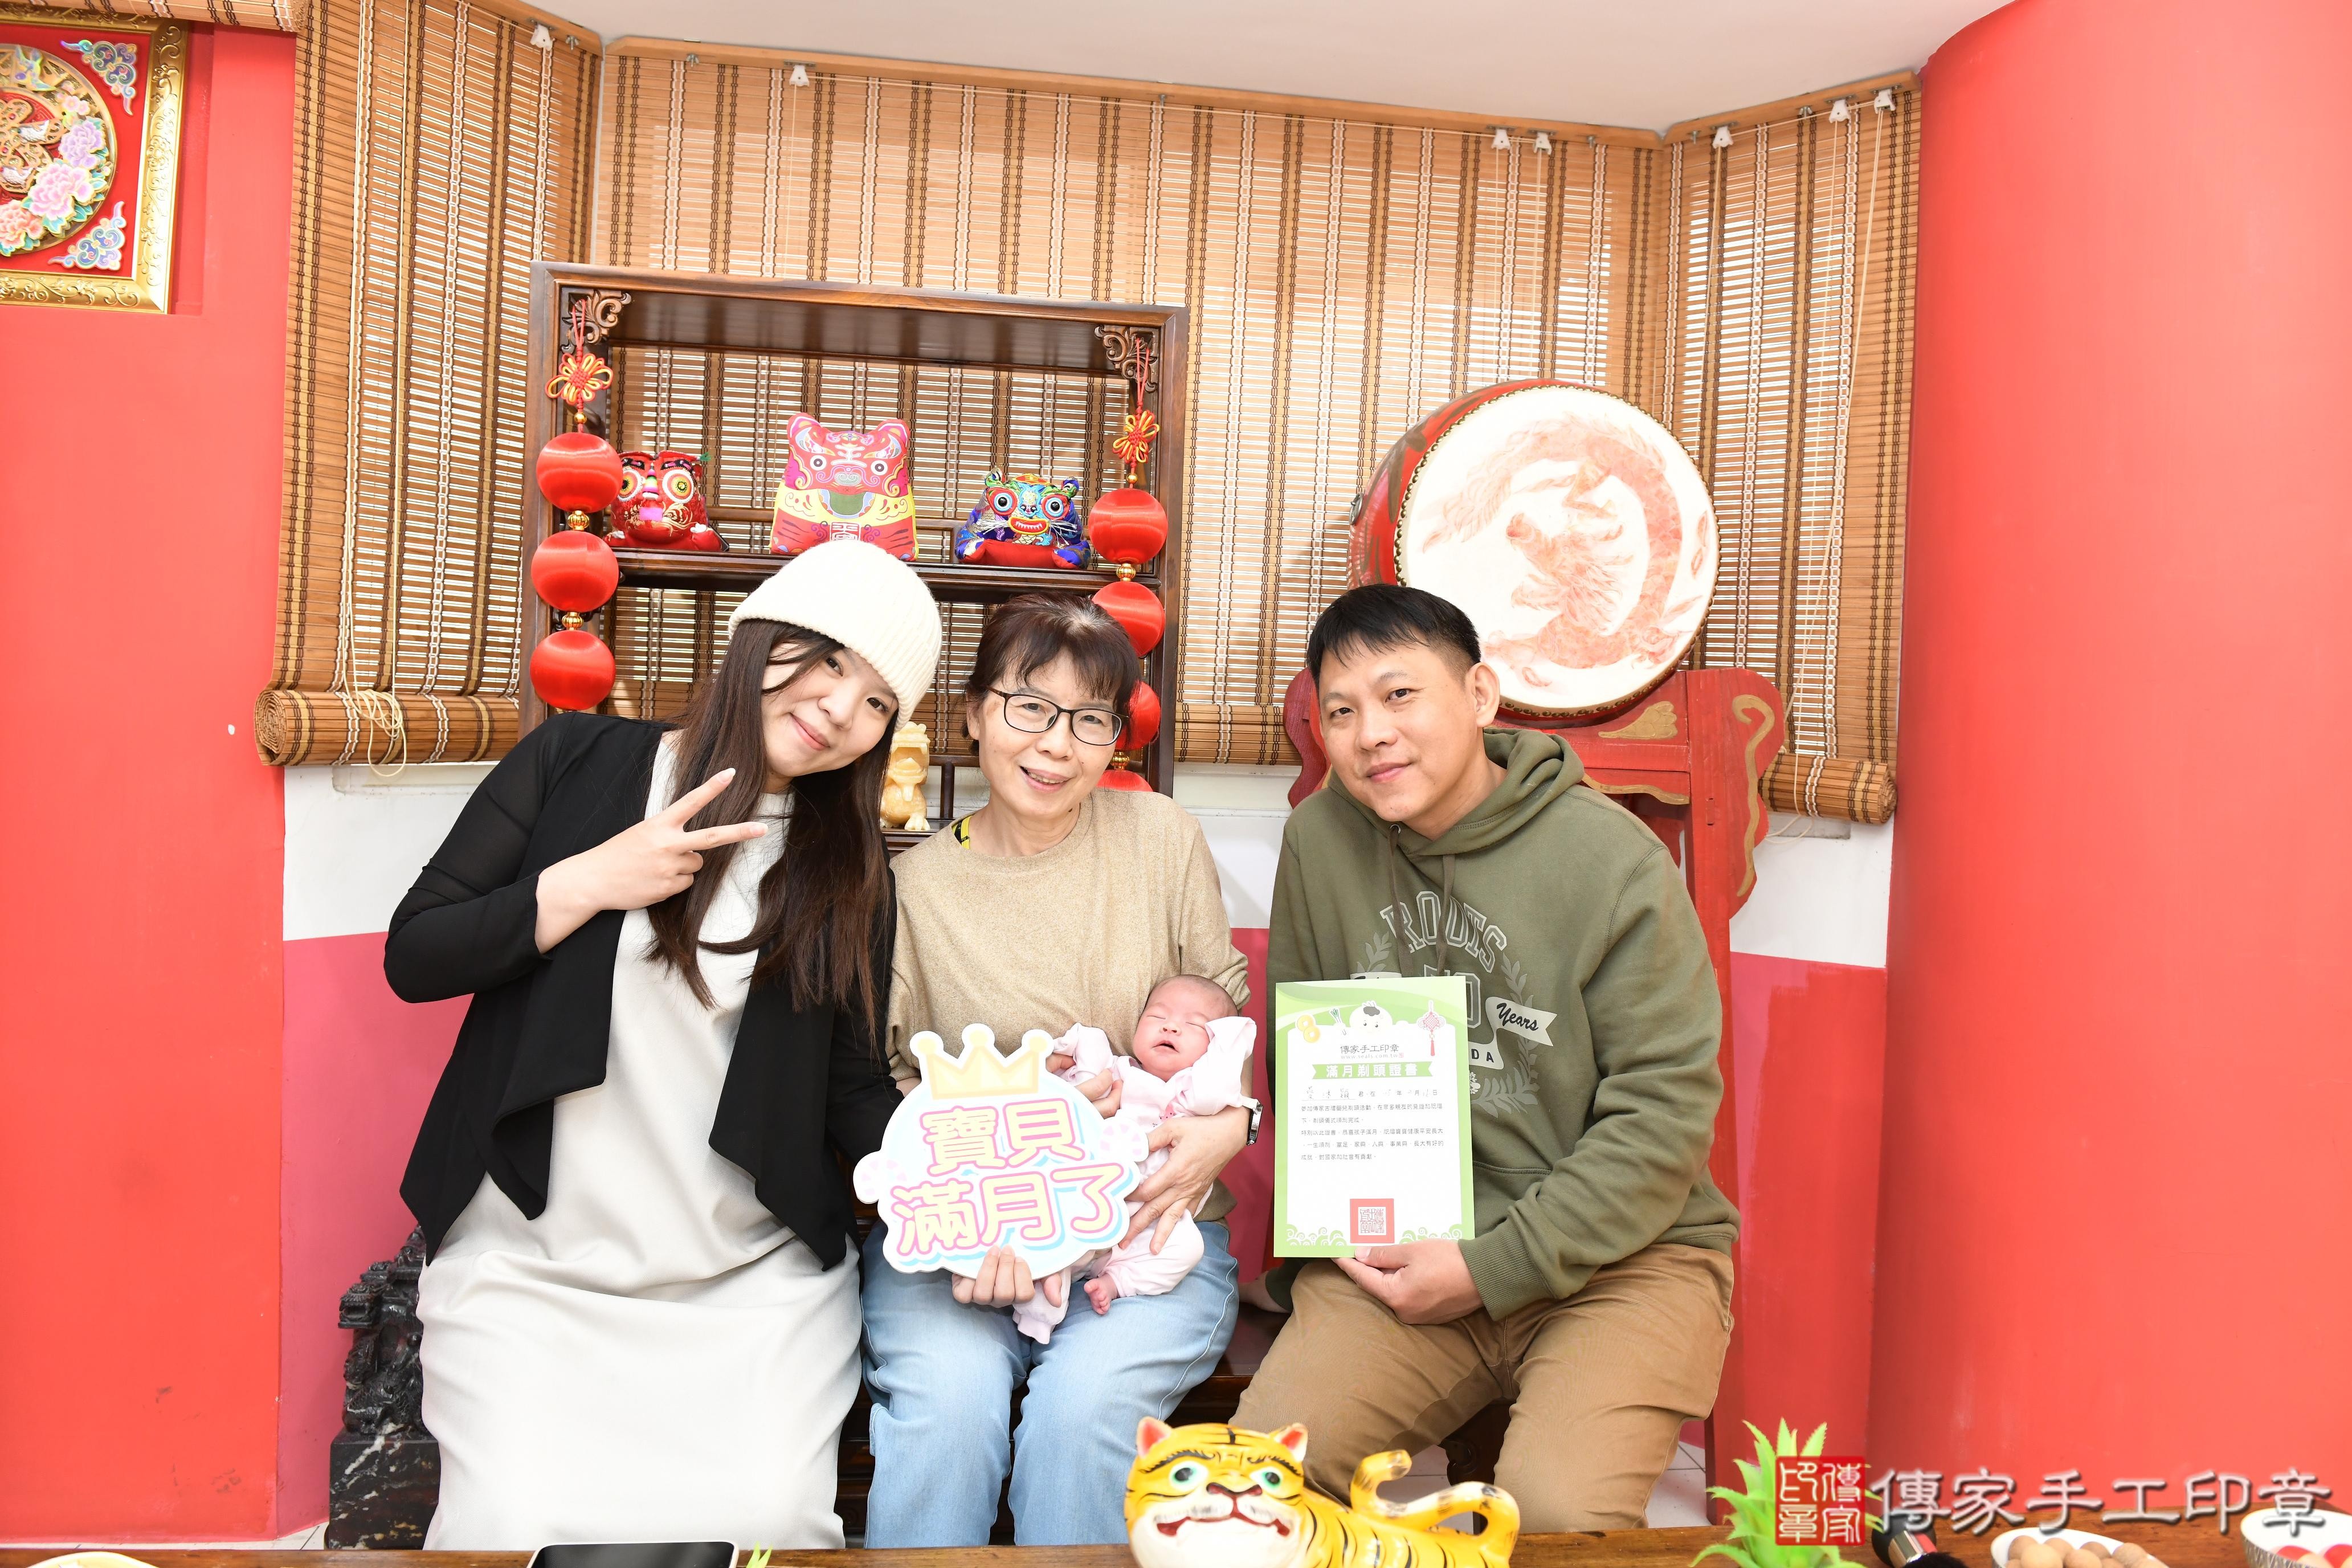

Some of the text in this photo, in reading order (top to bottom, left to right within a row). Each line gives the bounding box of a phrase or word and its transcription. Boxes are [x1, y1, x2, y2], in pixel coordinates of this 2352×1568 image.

[1496, 1002, 1540, 1032] Years
[1340, 1044, 1399, 1054] 傳家手工印章
[1326, 1063, 1418, 1079] 滿月剃頭證書
[920, 1098, 1085, 1175] 寶貝
[891, 1163, 1124, 1256] 滿月了
